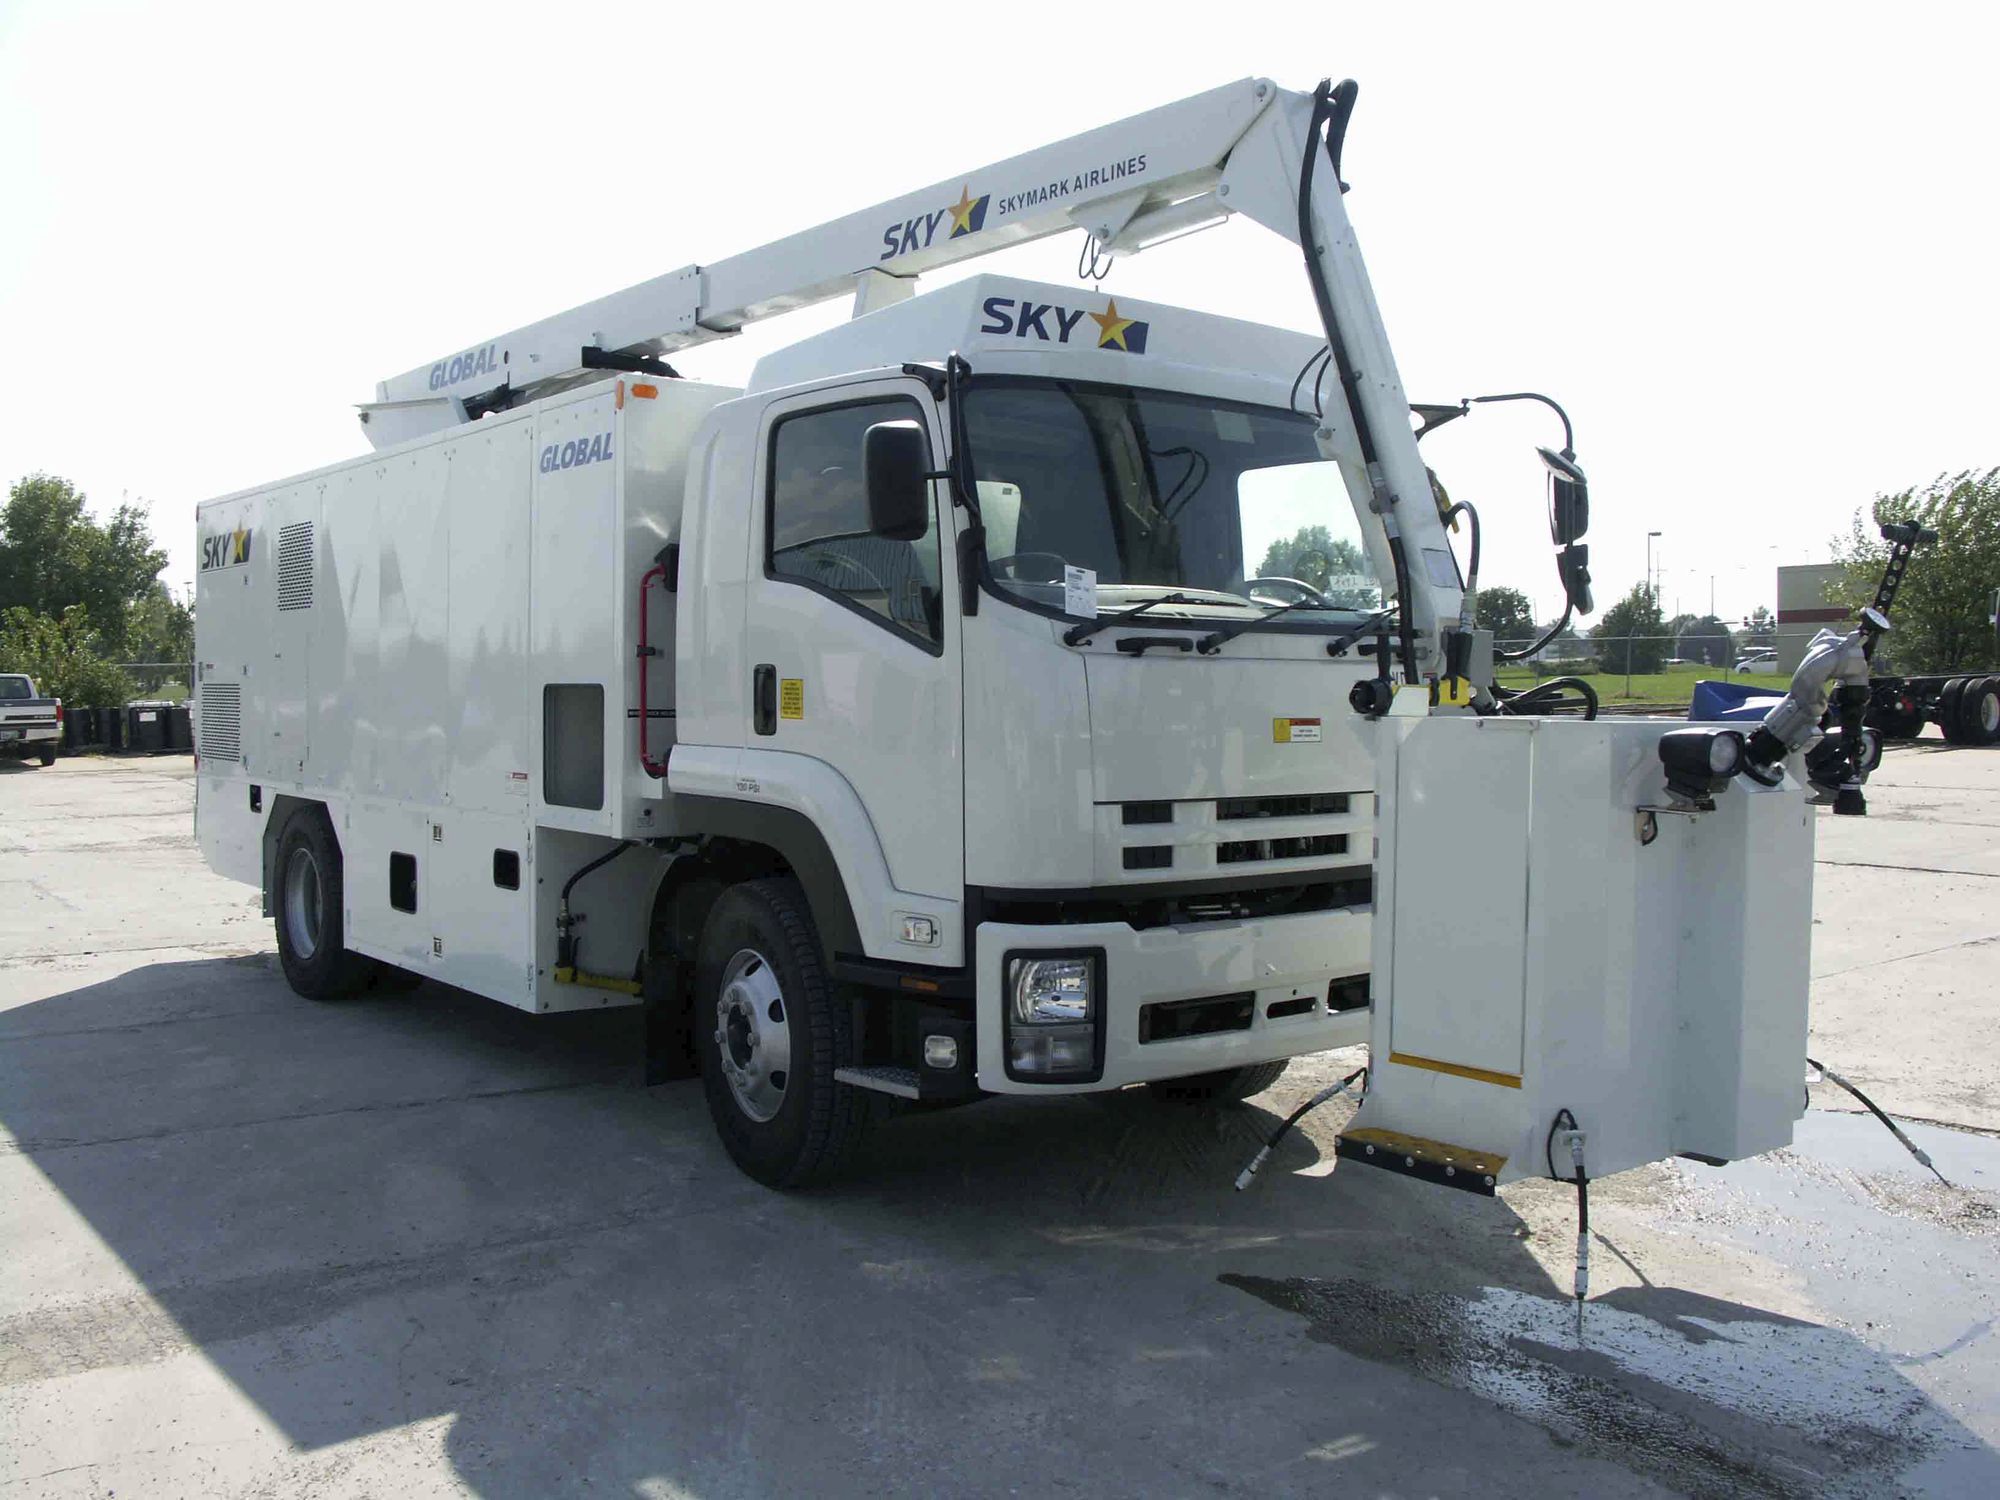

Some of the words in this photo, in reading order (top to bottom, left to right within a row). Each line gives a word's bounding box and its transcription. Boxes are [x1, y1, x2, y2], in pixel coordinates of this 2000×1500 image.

[999, 179, 1069, 215] SKYMARK
[1073, 155, 1147, 192] AIRLINES
[880, 209, 946, 260] SKY
[981, 297, 1085, 343] SKY
[429, 344, 497, 391] GLOBAL
[540, 432, 613, 473] GLOBAL
[201, 532, 232, 570] SKY
